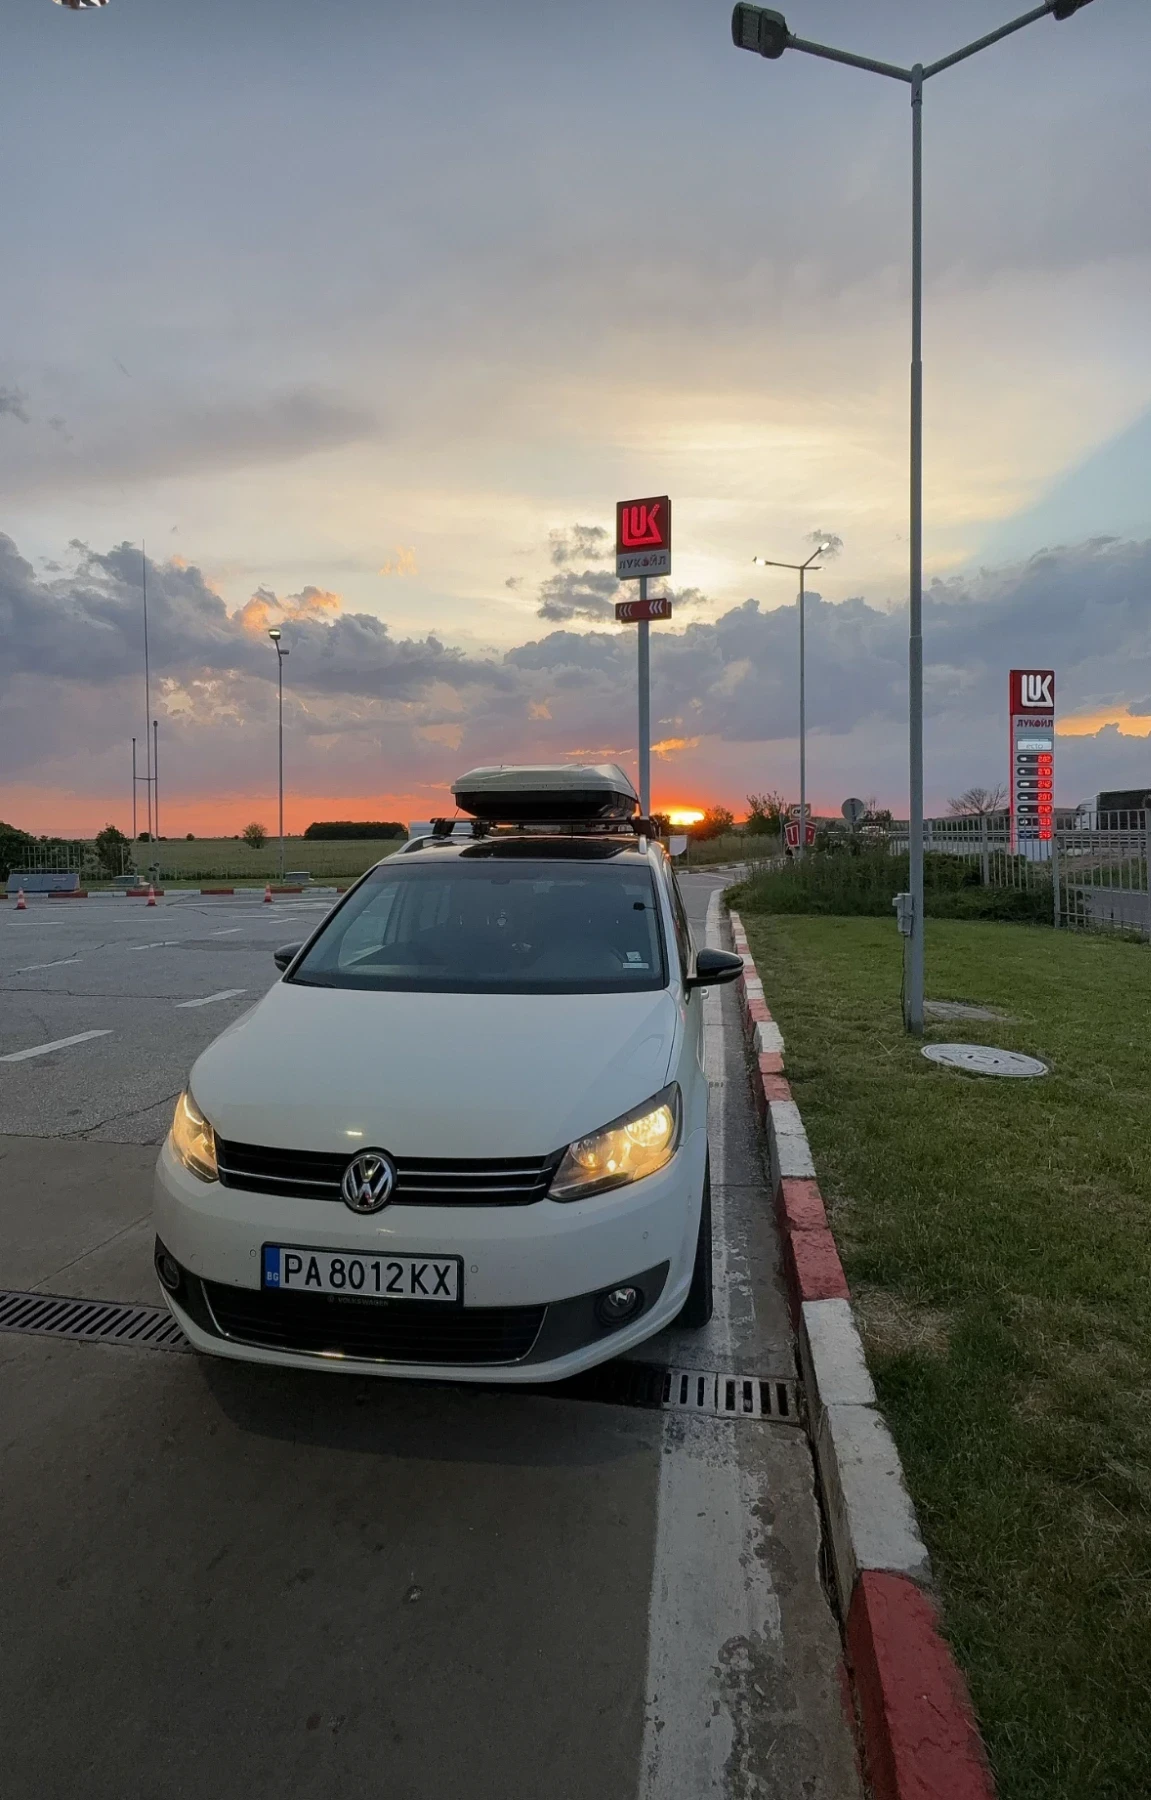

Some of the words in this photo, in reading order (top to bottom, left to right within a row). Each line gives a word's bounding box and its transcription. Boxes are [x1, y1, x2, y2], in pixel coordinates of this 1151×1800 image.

[618, 554, 667, 570] ЛУКОЙЛ
[1017, 718, 1053, 728] ЛУКОЙЛ
[266, 1271, 279, 1281] BG
